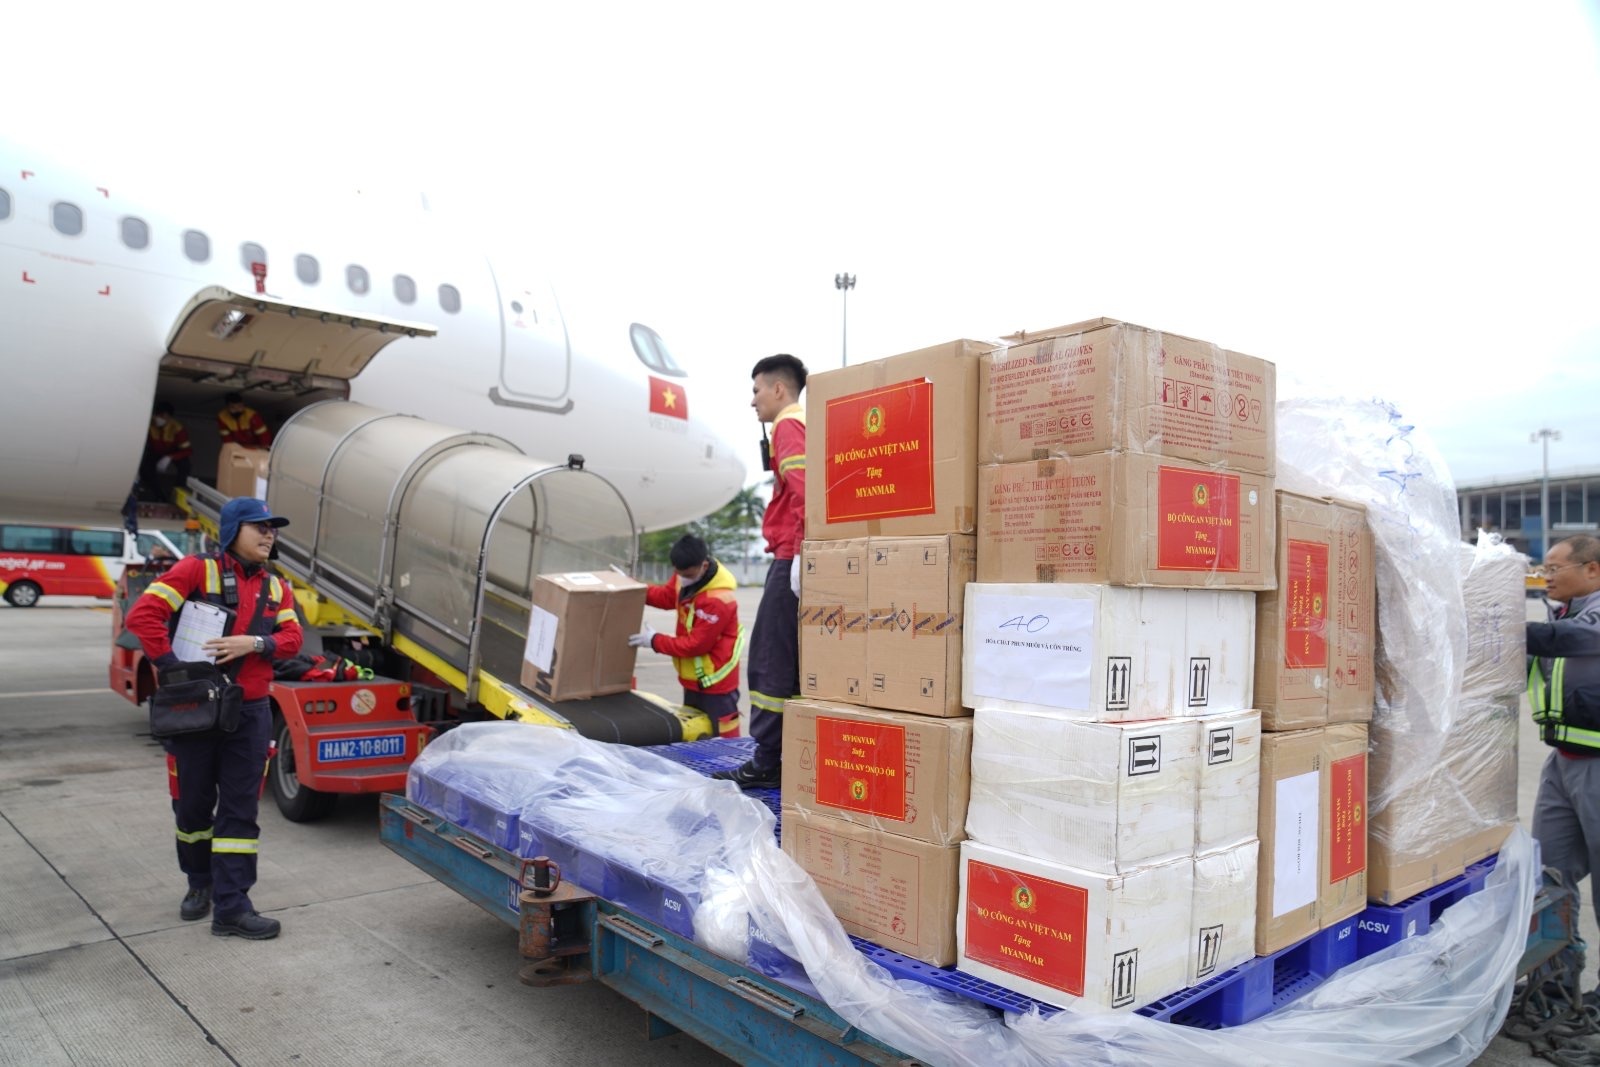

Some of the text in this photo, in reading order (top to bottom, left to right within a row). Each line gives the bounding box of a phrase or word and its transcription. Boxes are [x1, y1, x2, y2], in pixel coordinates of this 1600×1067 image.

[835, 440, 919, 465] BỘ CÔNG AN VIỆT NAM
[866, 467, 882, 479] Tặng
[856, 484, 895, 498] MYANMAR
[1168, 512, 1232, 527] BỘ CÔNG AN VIỆT NAM
[1185, 545, 1216, 555] MYANMAR
[999, 614, 1050, 633] 40
[842, 734, 876, 746] MYANMAR
[852, 748, 866, 758] Tặng
[824, 758, 895, 776] BỘ CÔNG AN VIỆT NAM
[664, 898, 681, 912] ACSV
[977, 907, 1072, 942] BỘ CÔNG AN VIỆT NAM
[1358, 920, 1390, 934] ACSV
[1338, 926, 1351, 941] ACSV
[1014, 934, 1031, 948] Tặng
[1000, 945, 1044, 966] MYANMAR
